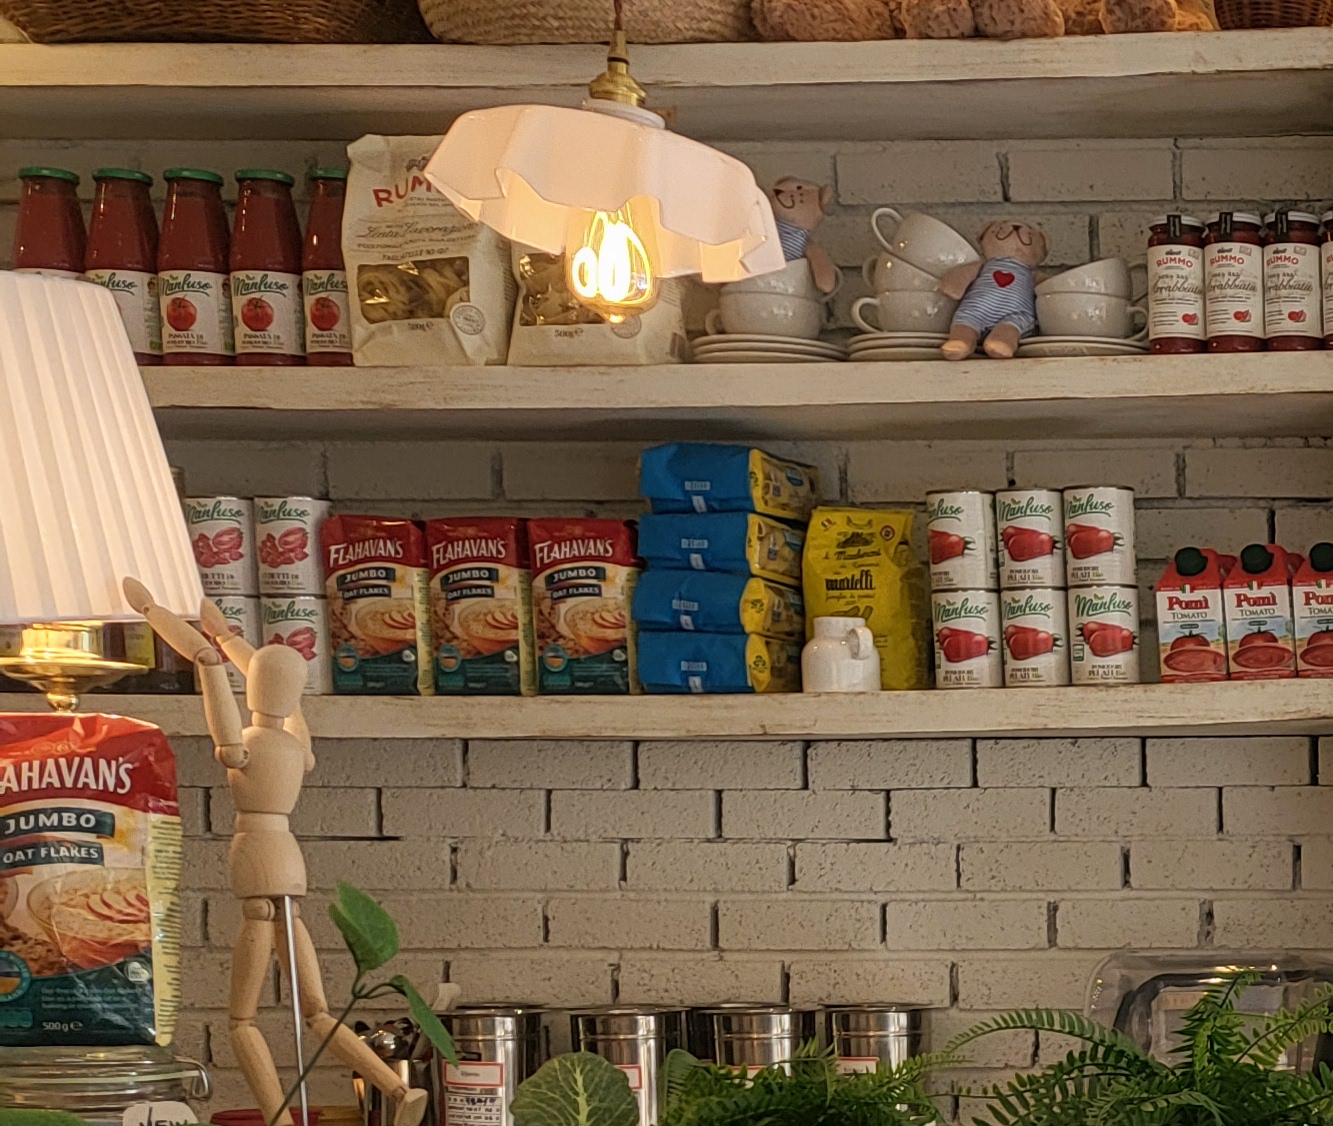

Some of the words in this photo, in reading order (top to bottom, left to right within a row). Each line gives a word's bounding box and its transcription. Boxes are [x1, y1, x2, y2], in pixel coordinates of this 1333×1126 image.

[1156, 256, 1194, 268] RUMMO
[1210, 254, 1245, 265] RUMMO
[1266, 254, 1299, 266] RUMMO
[329, 537, 404, 565] FLAHAVAN'S
[431, 537, 507, 568] FLAHAVAN'S
[534, 537, 614, 566] FLAHAVAN'S
[343, 568, 387, 584] JUMBO
[446, 569, 491, 583] JUMBO
[552, 567, 596, 583] JUMBO
[825, 569, 877, 592] martelli
[1172, 611, 1208, 620] TOMATO
[1240, 608, 1276, 617] TOMATO
[4, 813, 97, 835] JUMBO
[3, 847, 34, 865] OAT
[40, 845, 100, 860] FLAKES
